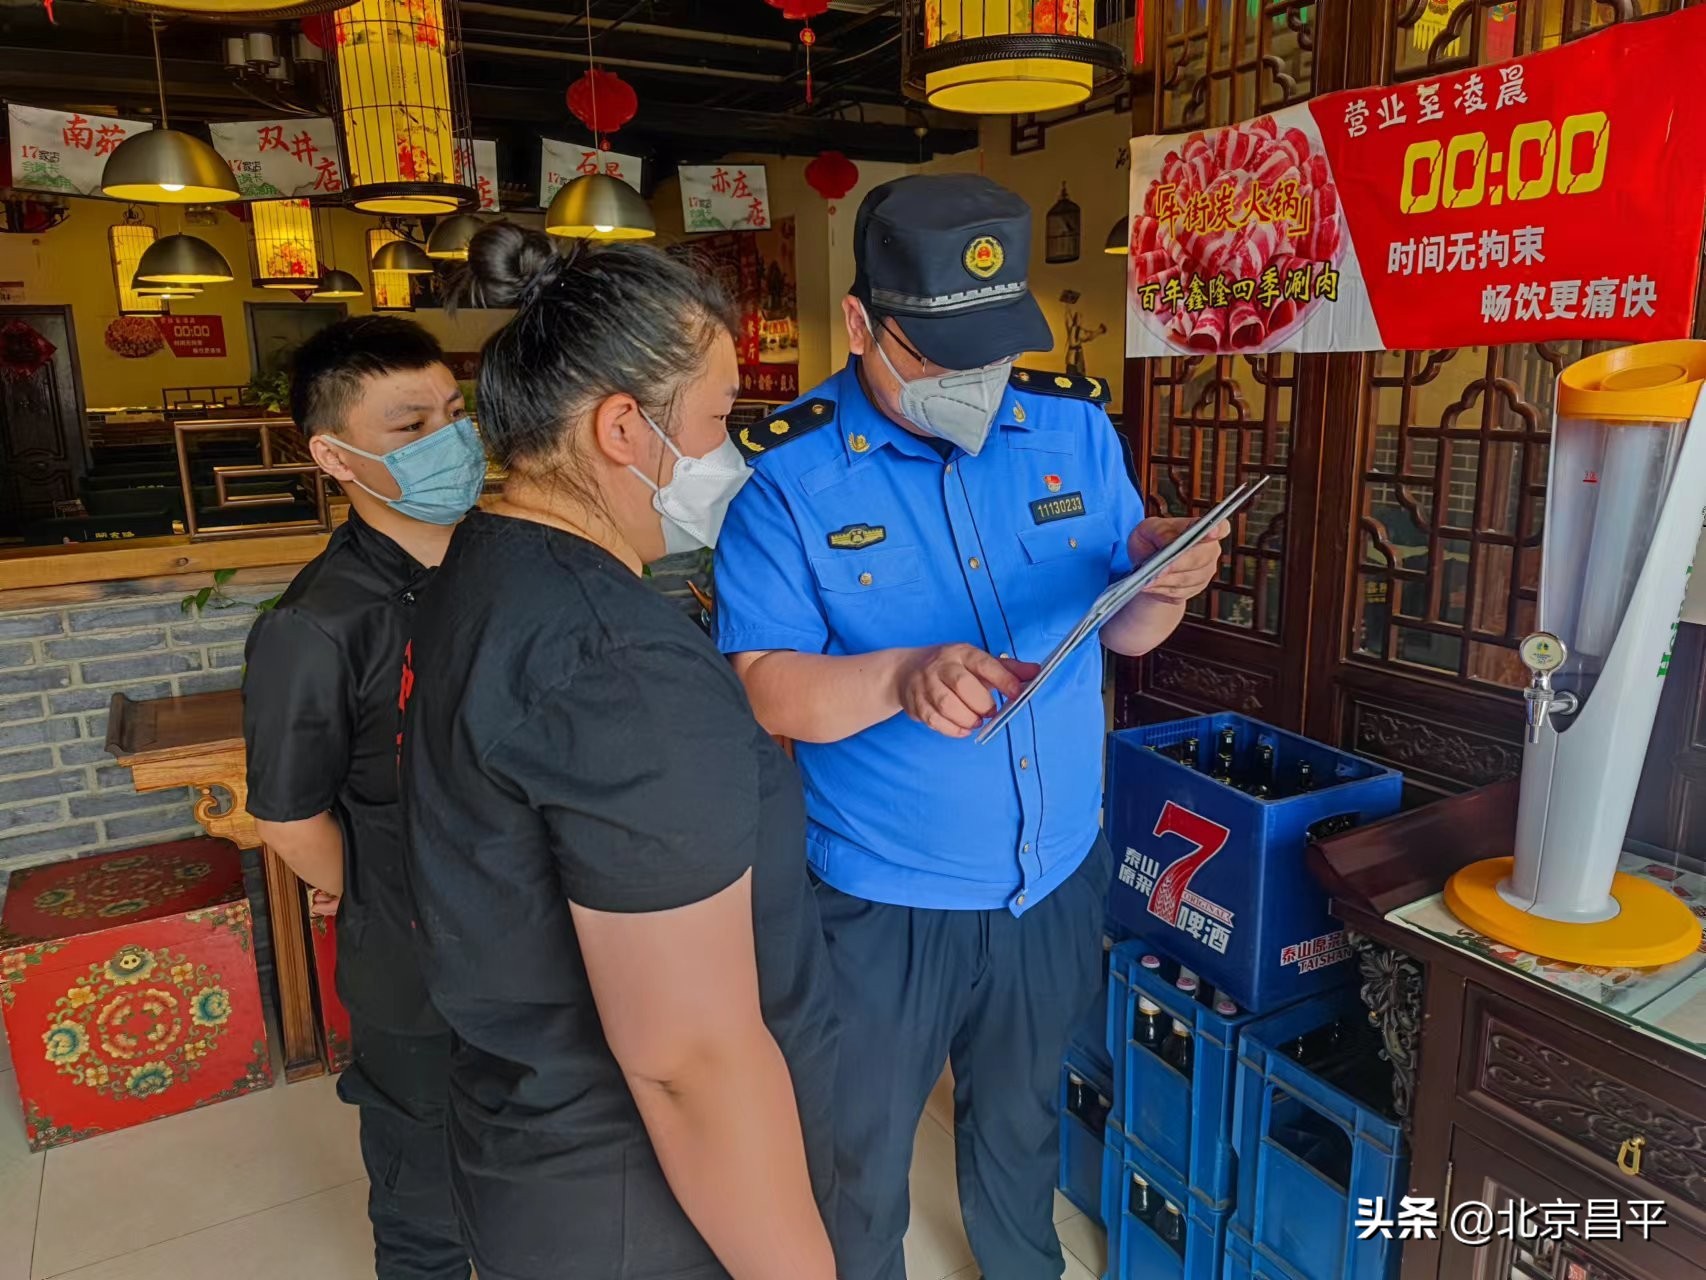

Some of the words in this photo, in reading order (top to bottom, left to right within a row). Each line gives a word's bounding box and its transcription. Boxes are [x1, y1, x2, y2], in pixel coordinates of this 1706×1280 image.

[1344, 64, 1528, 138] 营业至凌晨
[257, 125, 342, 192] 双井店
[1400, 111, 1610, 214] 00:00
[711, 167, 766, 227] 亦庄店
[1387, 225, 1547, 276] 时间无拘束
[1137, 261, 1341, 315] 百年鑫隆四季涮肉
[1480, 273, 1659, 324] 畅饮更痛快
[1147, 800, 1231, 928] 7
[1176, 905, 1233, 955] 啤酒
